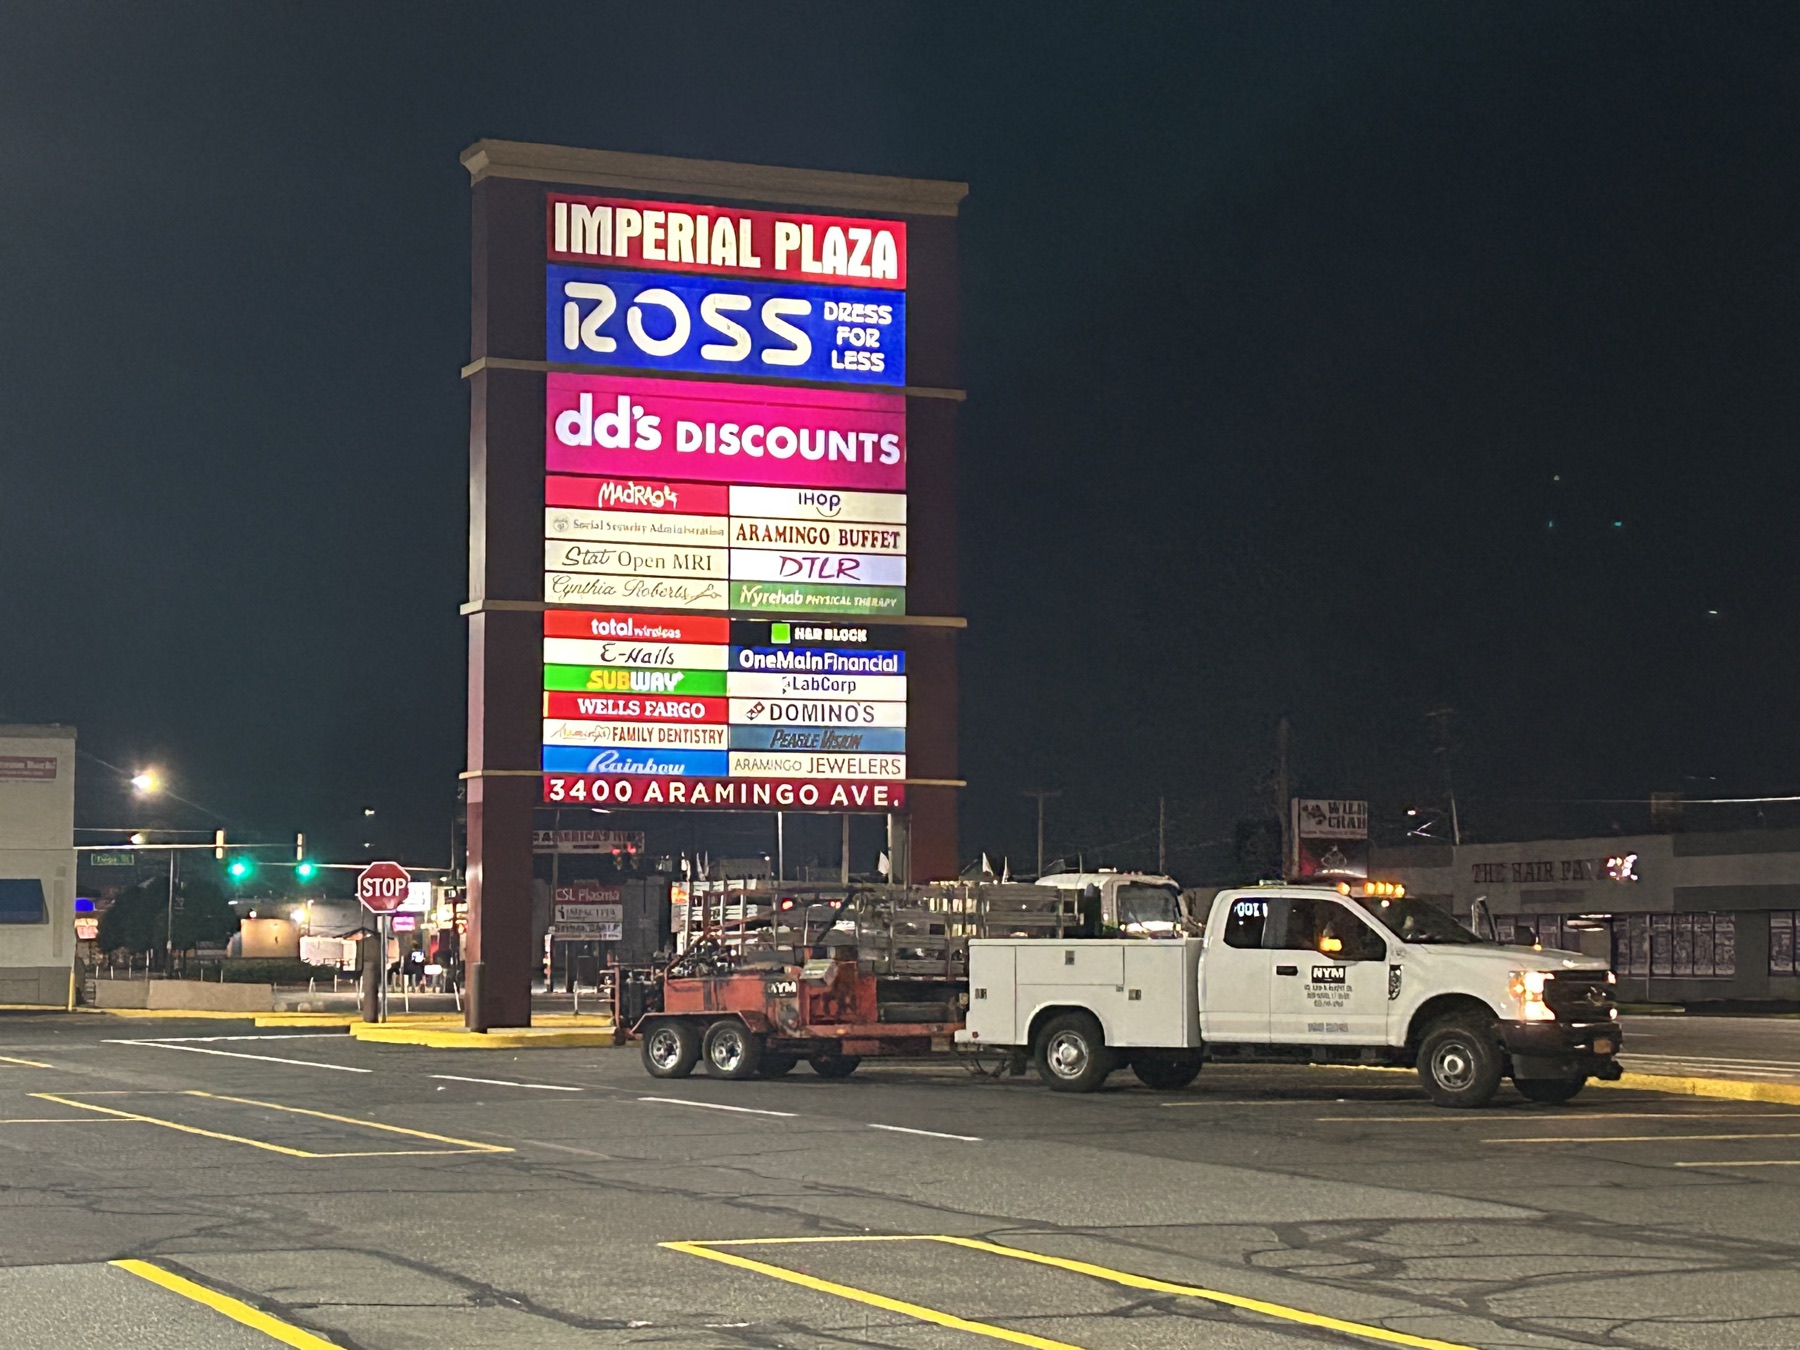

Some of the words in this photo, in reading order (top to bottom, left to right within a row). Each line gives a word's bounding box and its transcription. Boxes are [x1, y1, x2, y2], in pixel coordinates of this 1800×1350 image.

[554, 202, 761, 268] IMPERIAL
[774, 220, 898, 280] PLAZA
[564, 281, 813, 366] ROSS
[823, 301, 892, 325] DRESS
[836, 326, 880, 349] FOR
[831, 350, 885, 372] LESS
[555, 392, 662, 451] dd's
[676, 421, 900, 465] DISCOUNTS
[573, 519, 604, 531] Social
[736, 523, 830, 545] ARAMINGO
[838, 529, 900, 549] BUFFET
[562, 546, 616, 566] Stat
[618, 551, 665, 571] Open
[673, 554, 712, 571] MRI
[779, 555, 861, 581] DTLR
[552, 575, 616, 601] Cynthia
[806, 594, 851, 606] PHYSICAL
[854, 596, 897, 608] THERAPY
[824, 628, 867, 642] BLOCK
[586, 670, 684, 692] SUBWAY
[792, 676, 856, 694] LabCorp
[577, 698, 640, 716] WELLS
[644, 701, 706, 719] FARGO
[769, 701, 875, 723] DOMINO'S
[612, 726, 654, 742] FAMILY
[658, 728, 724, 744] DENTISTRY
[587, 750, 685, 775] Rainbow
[734, 758, 802, 772] ARAMINGO
[806, 757, 901, 775] JEWELERS
[550, 779, 632, 802] 3400
[644, 780, 819, 804] ARAMINGO
[830, 785, 899, 806] AVE.
[362, 877, 406, 897] STOP
[556, 888, 575, 901] CSL
